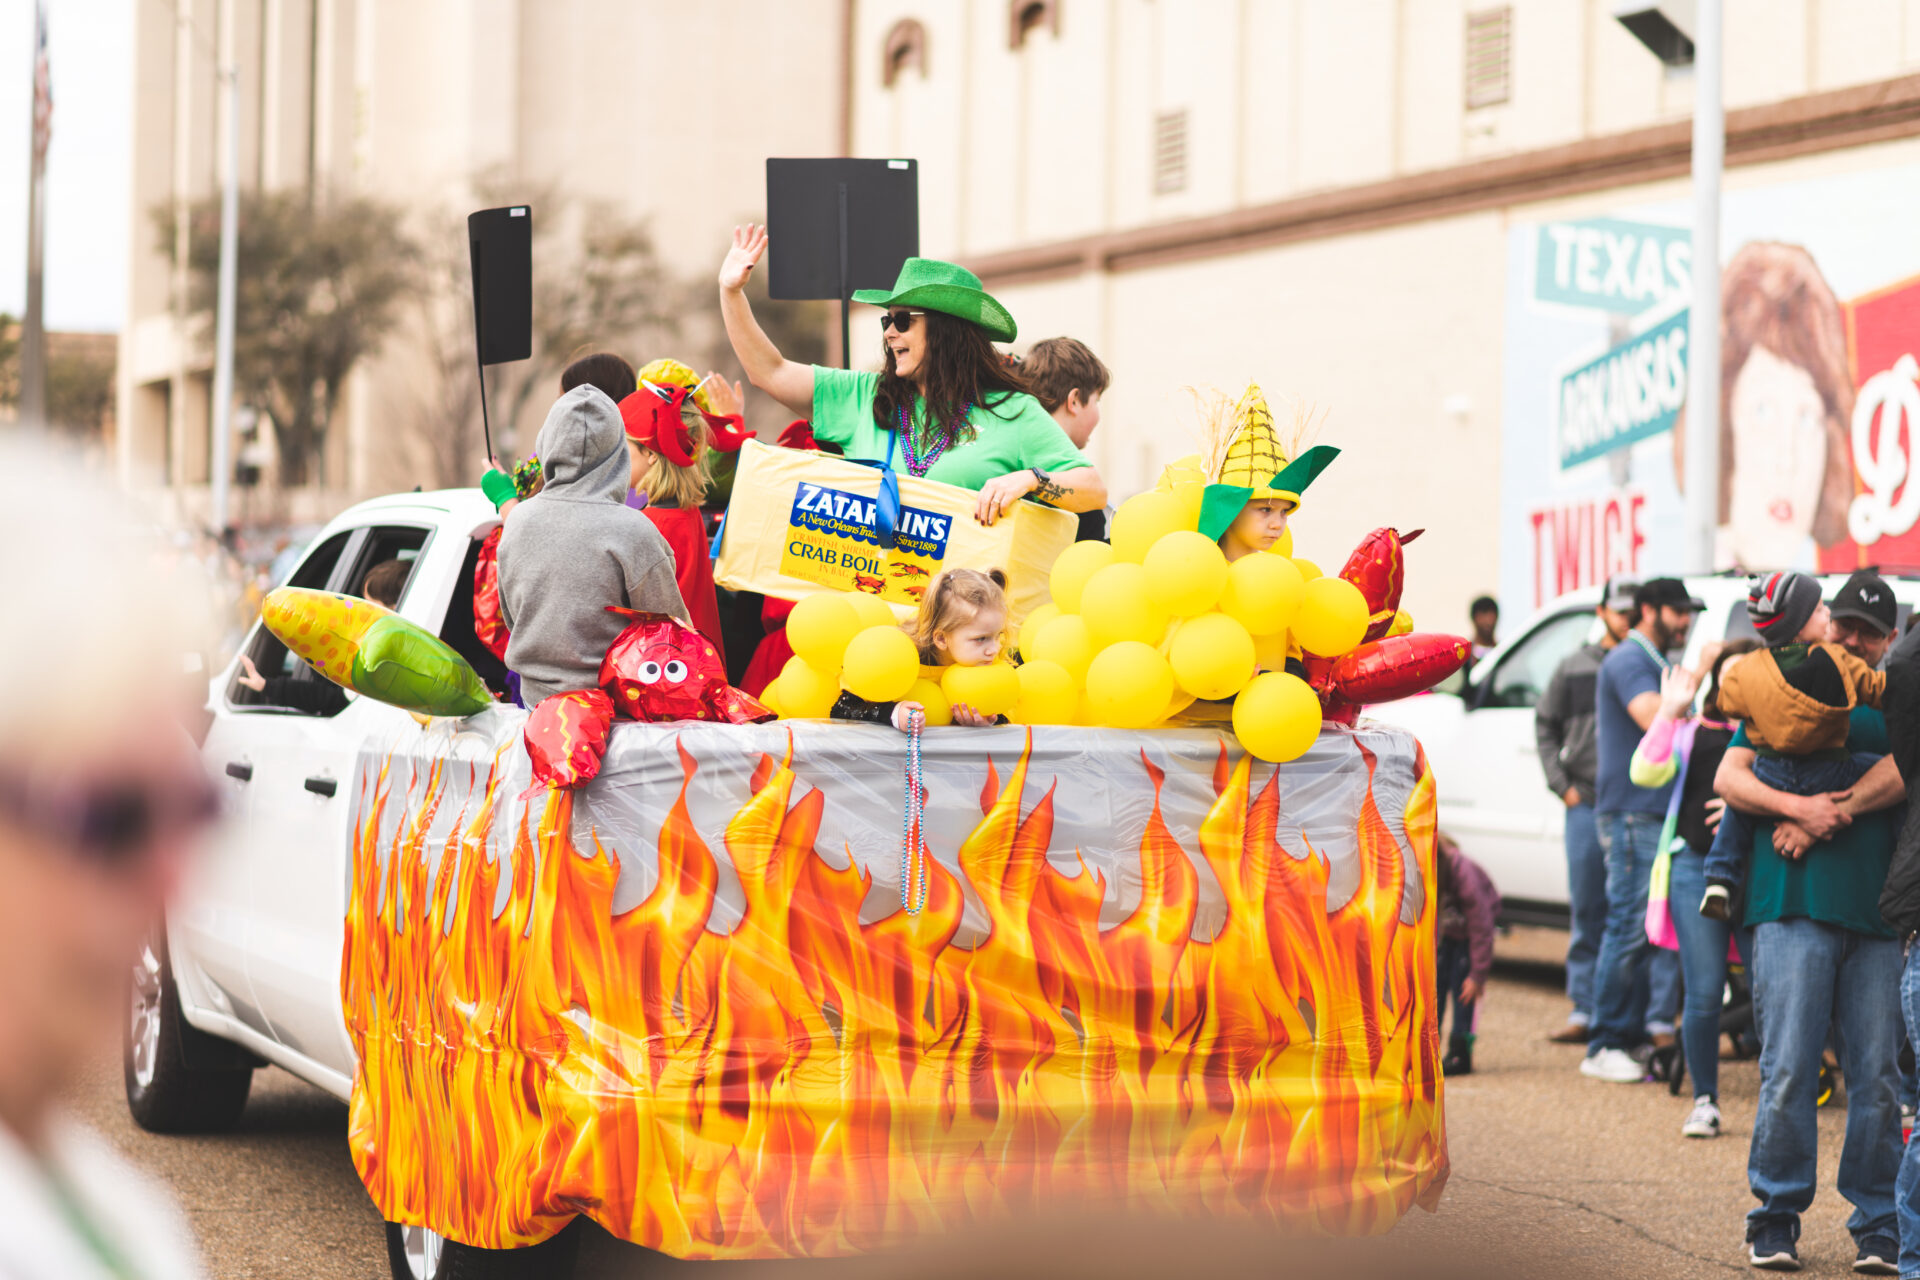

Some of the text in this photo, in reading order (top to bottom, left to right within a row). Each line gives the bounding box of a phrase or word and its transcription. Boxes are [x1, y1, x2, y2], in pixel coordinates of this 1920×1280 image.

[1549, 221, 1692, 302] TEXAS
[796, 484, 947, 541] ZATARIN'S
[798, 512, 807, 522] A
[807, 512, 828, 527] New
[827, 518, 860, 534] Orleans
[789, 541, 837, 564] CRAB
[840, 553, 884, 577] BOIL
[896, 534, 919, 549] Since
[919, 541, 938, 552] 1889
